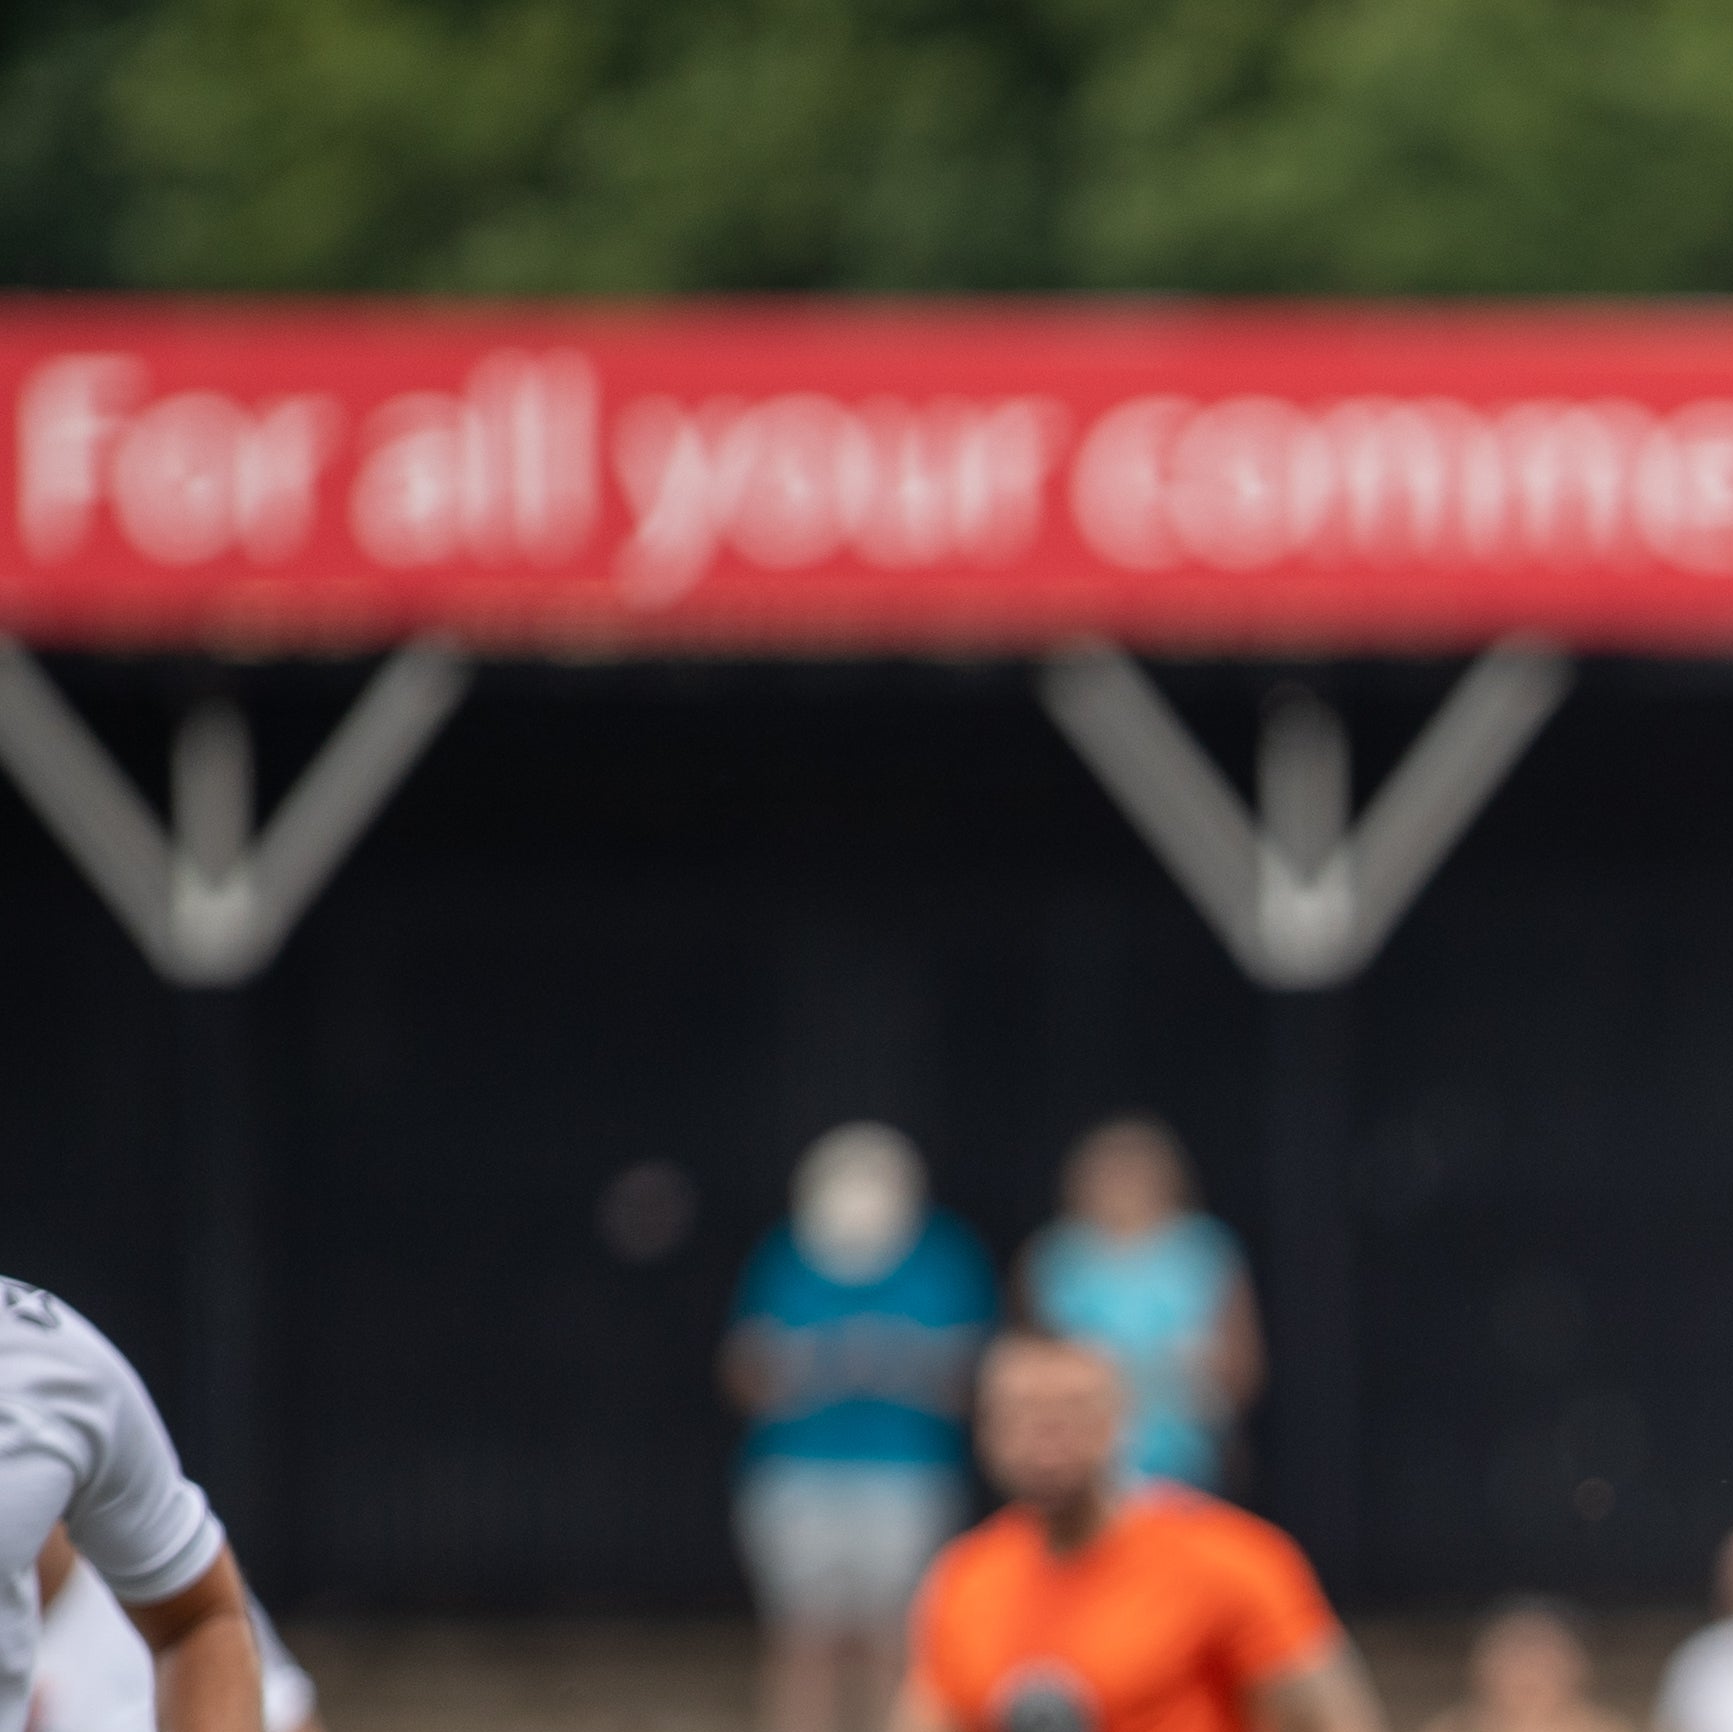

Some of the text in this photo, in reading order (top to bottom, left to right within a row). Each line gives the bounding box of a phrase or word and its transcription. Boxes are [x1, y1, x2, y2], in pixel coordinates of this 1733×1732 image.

[18, 350, 348, 570] For
[350, 345, 600, 570] all
[610, 388, 1066, 612] your
